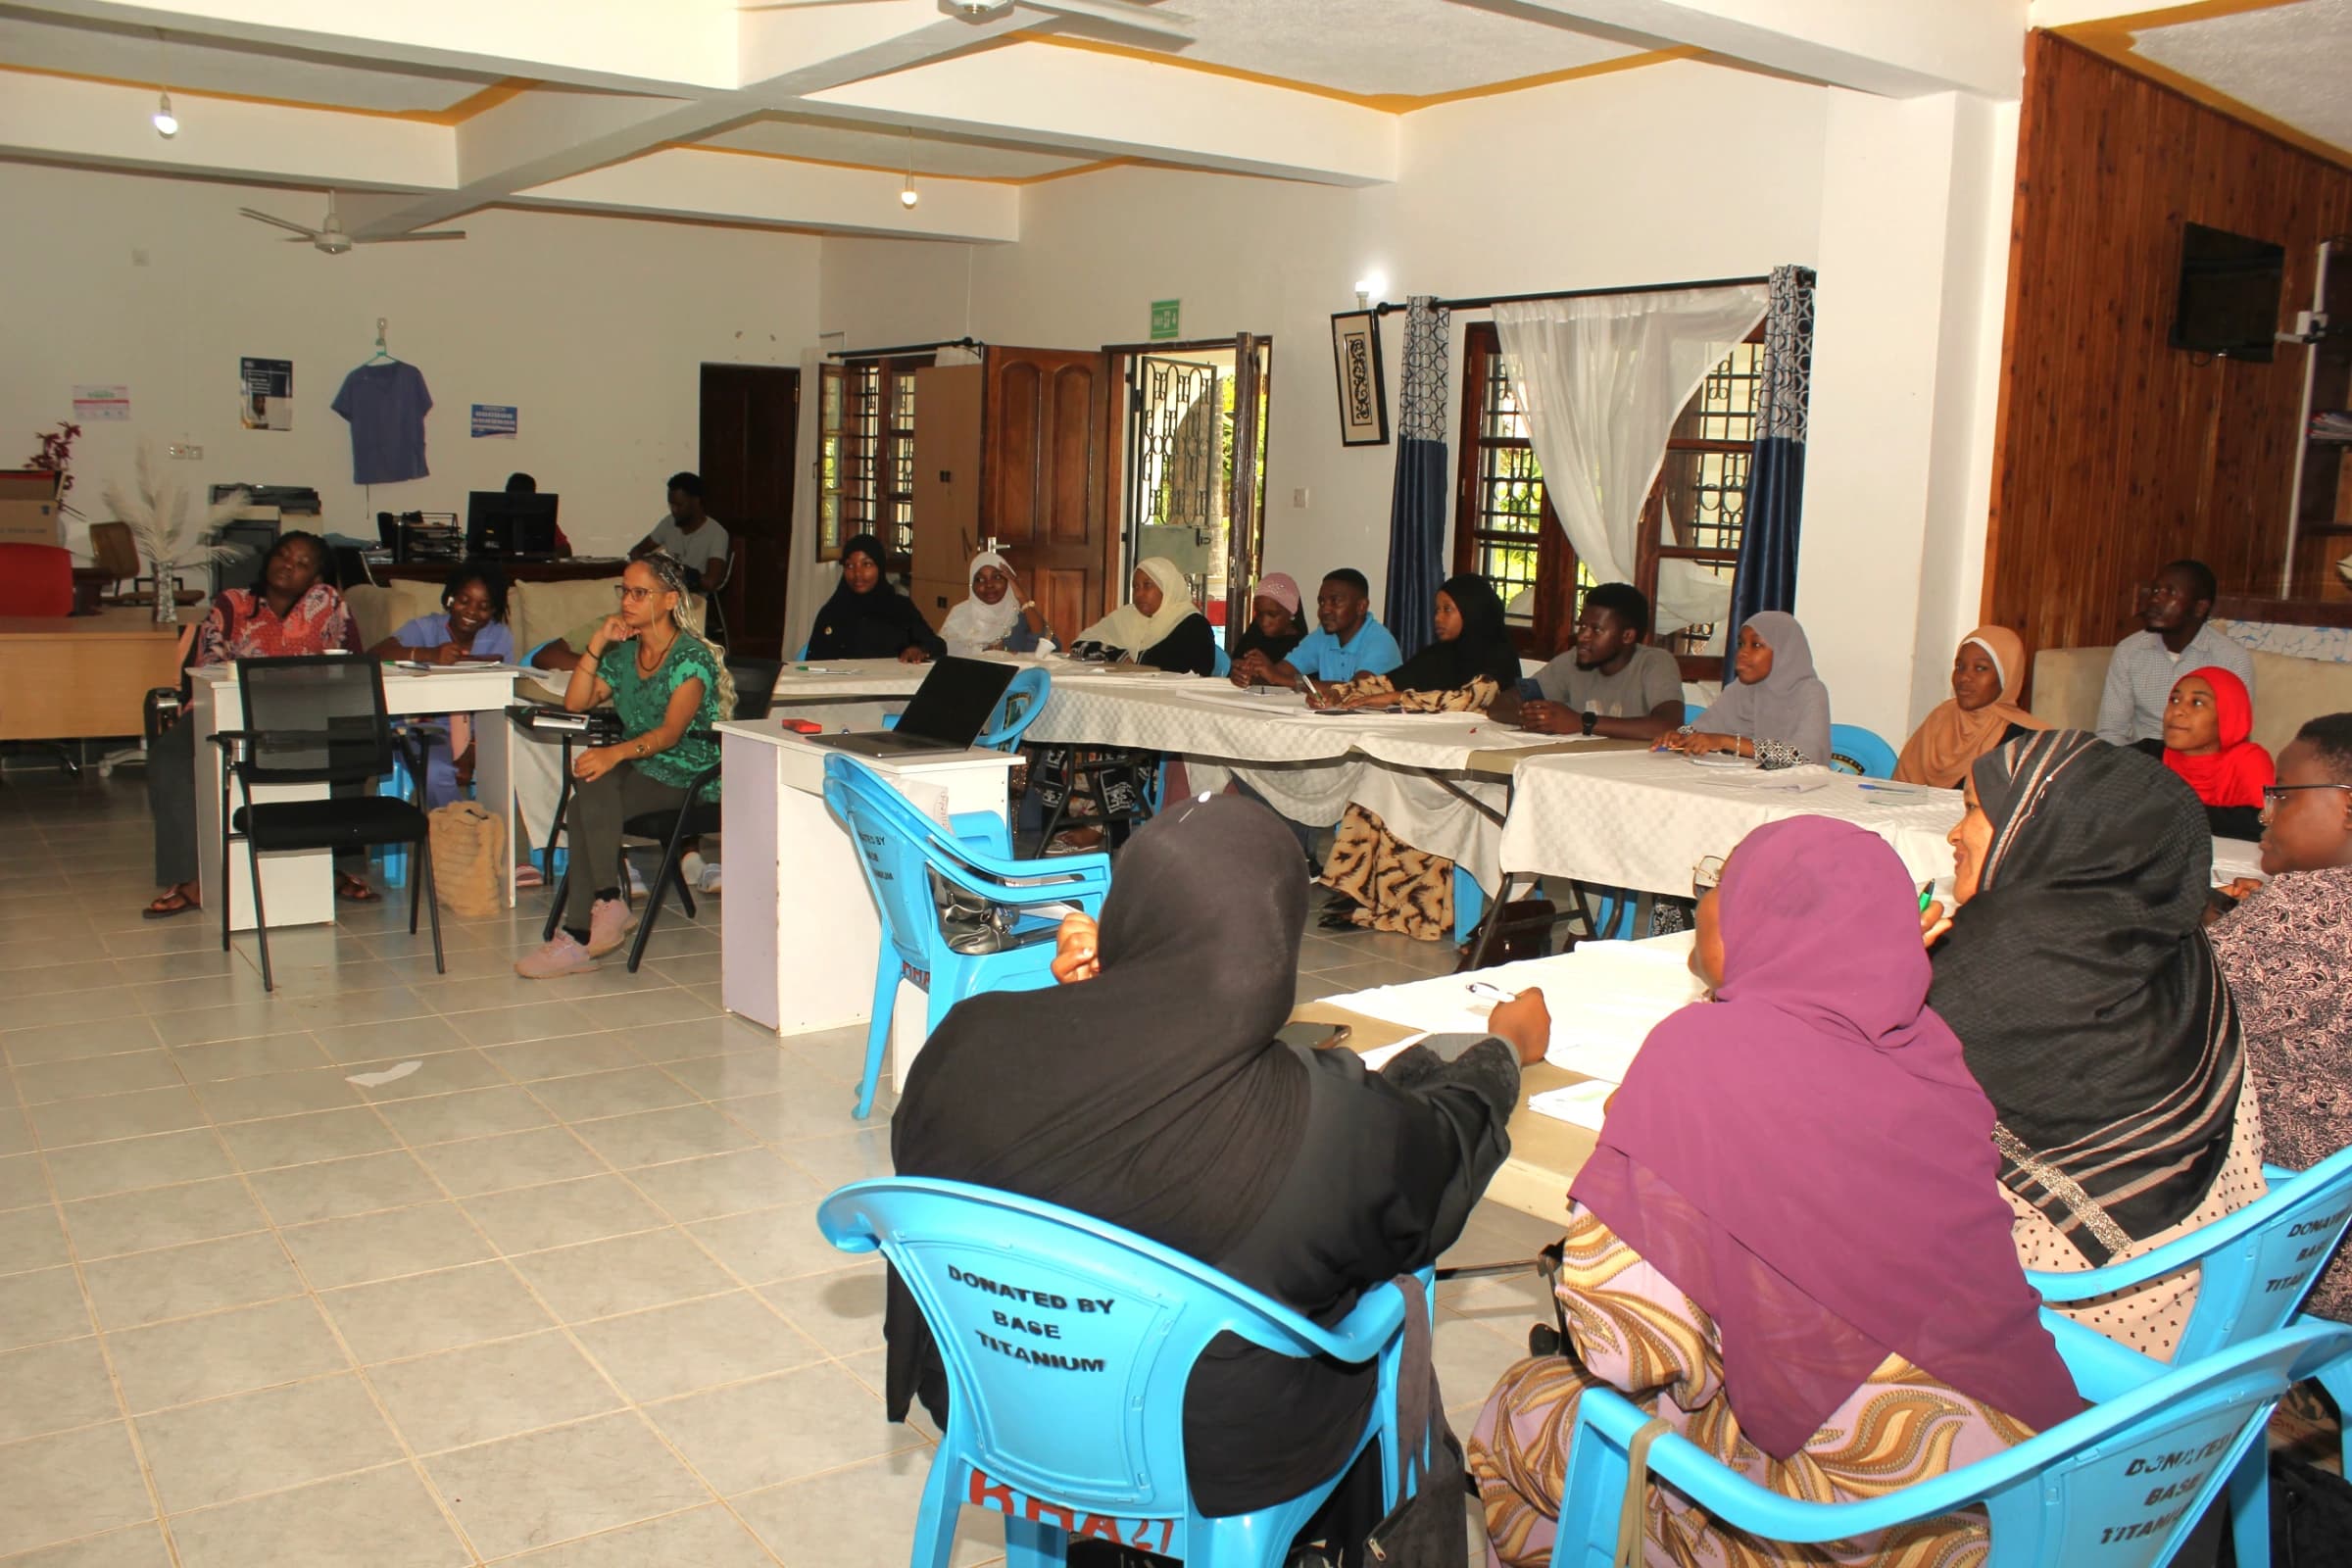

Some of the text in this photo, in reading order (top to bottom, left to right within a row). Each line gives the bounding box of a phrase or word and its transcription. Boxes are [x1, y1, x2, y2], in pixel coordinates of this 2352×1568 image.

[948, 1263, 1115, 1314] DONATED BY
[992, 1309, 1061, 1340] BASE
[975, 1329, 1105, 1372] TITANIUM
[2144, 1472, 2203, 1506] BASE
